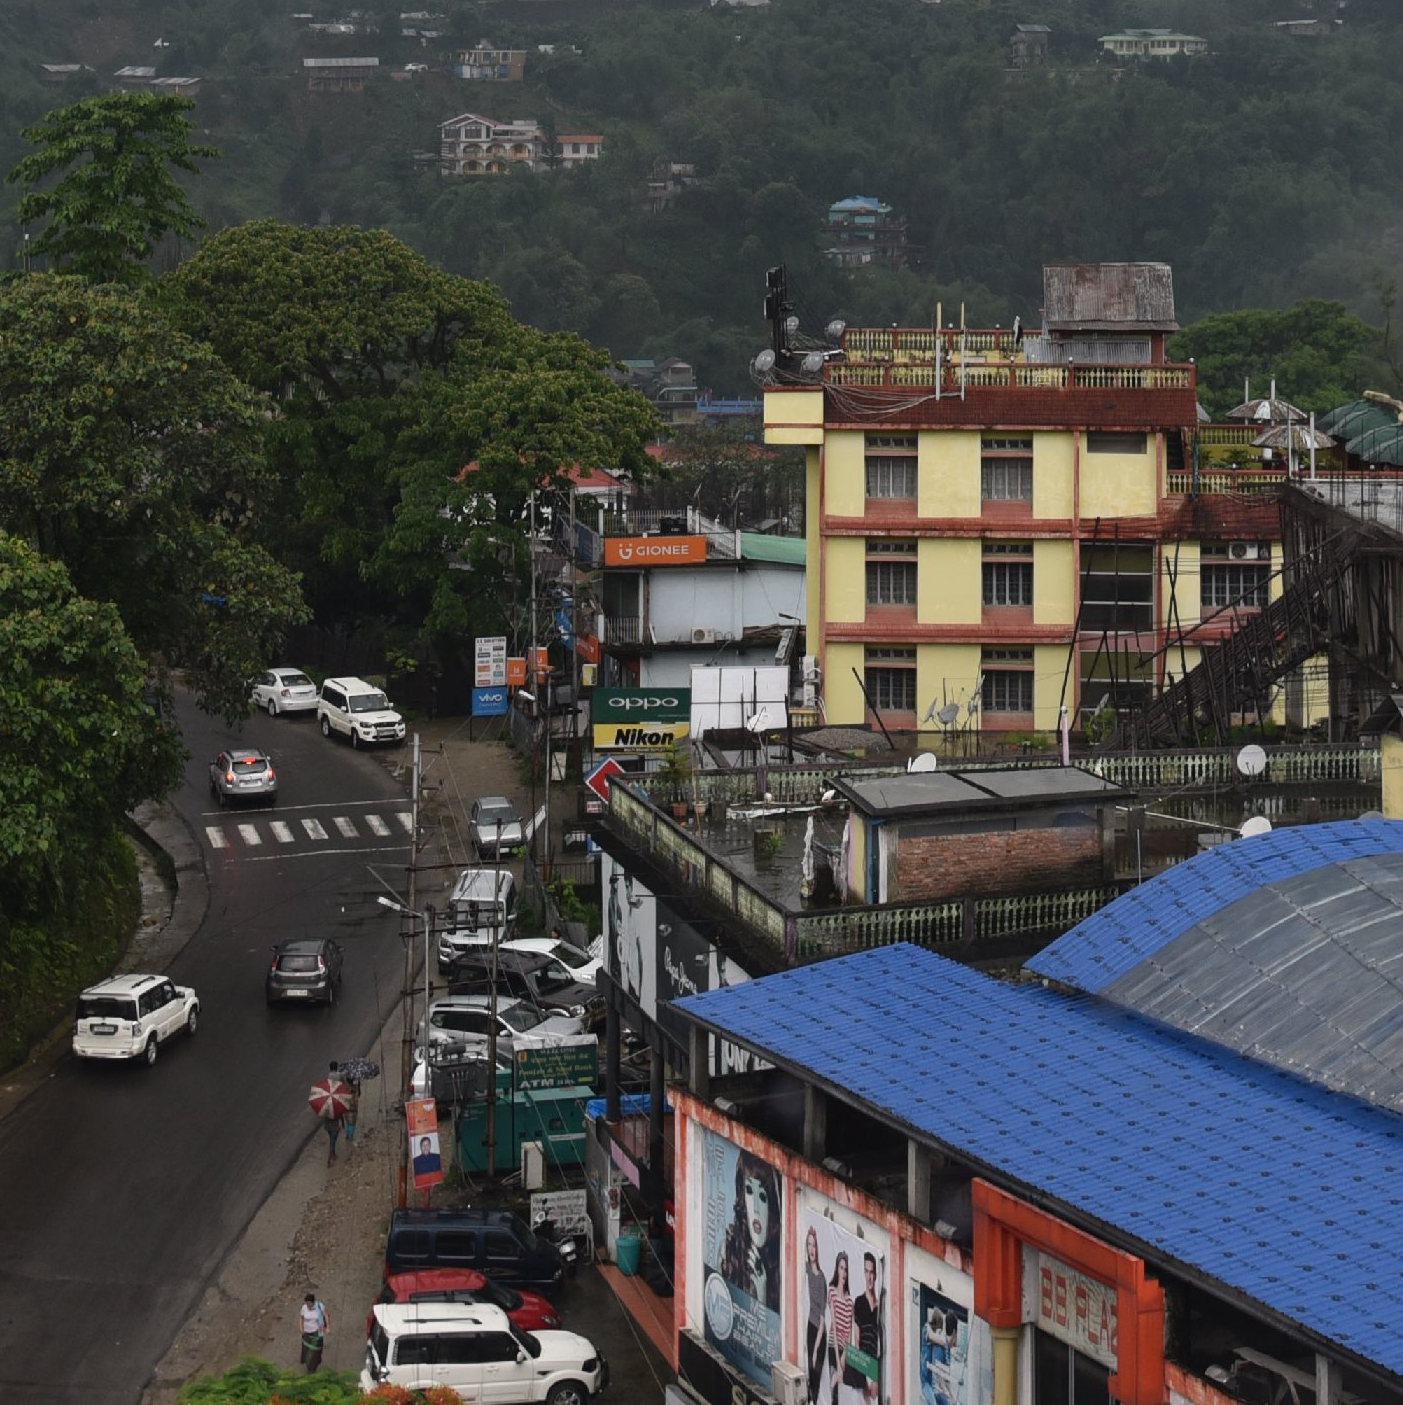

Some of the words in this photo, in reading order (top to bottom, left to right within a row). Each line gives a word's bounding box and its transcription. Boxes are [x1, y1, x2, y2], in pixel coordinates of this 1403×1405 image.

[636, 544, 689, 556] GIONEE
[478, 693, 503, 702] vivo
[615, 728, 674, 745] Nikon
[519, 1078, 554, 1089] ATM
